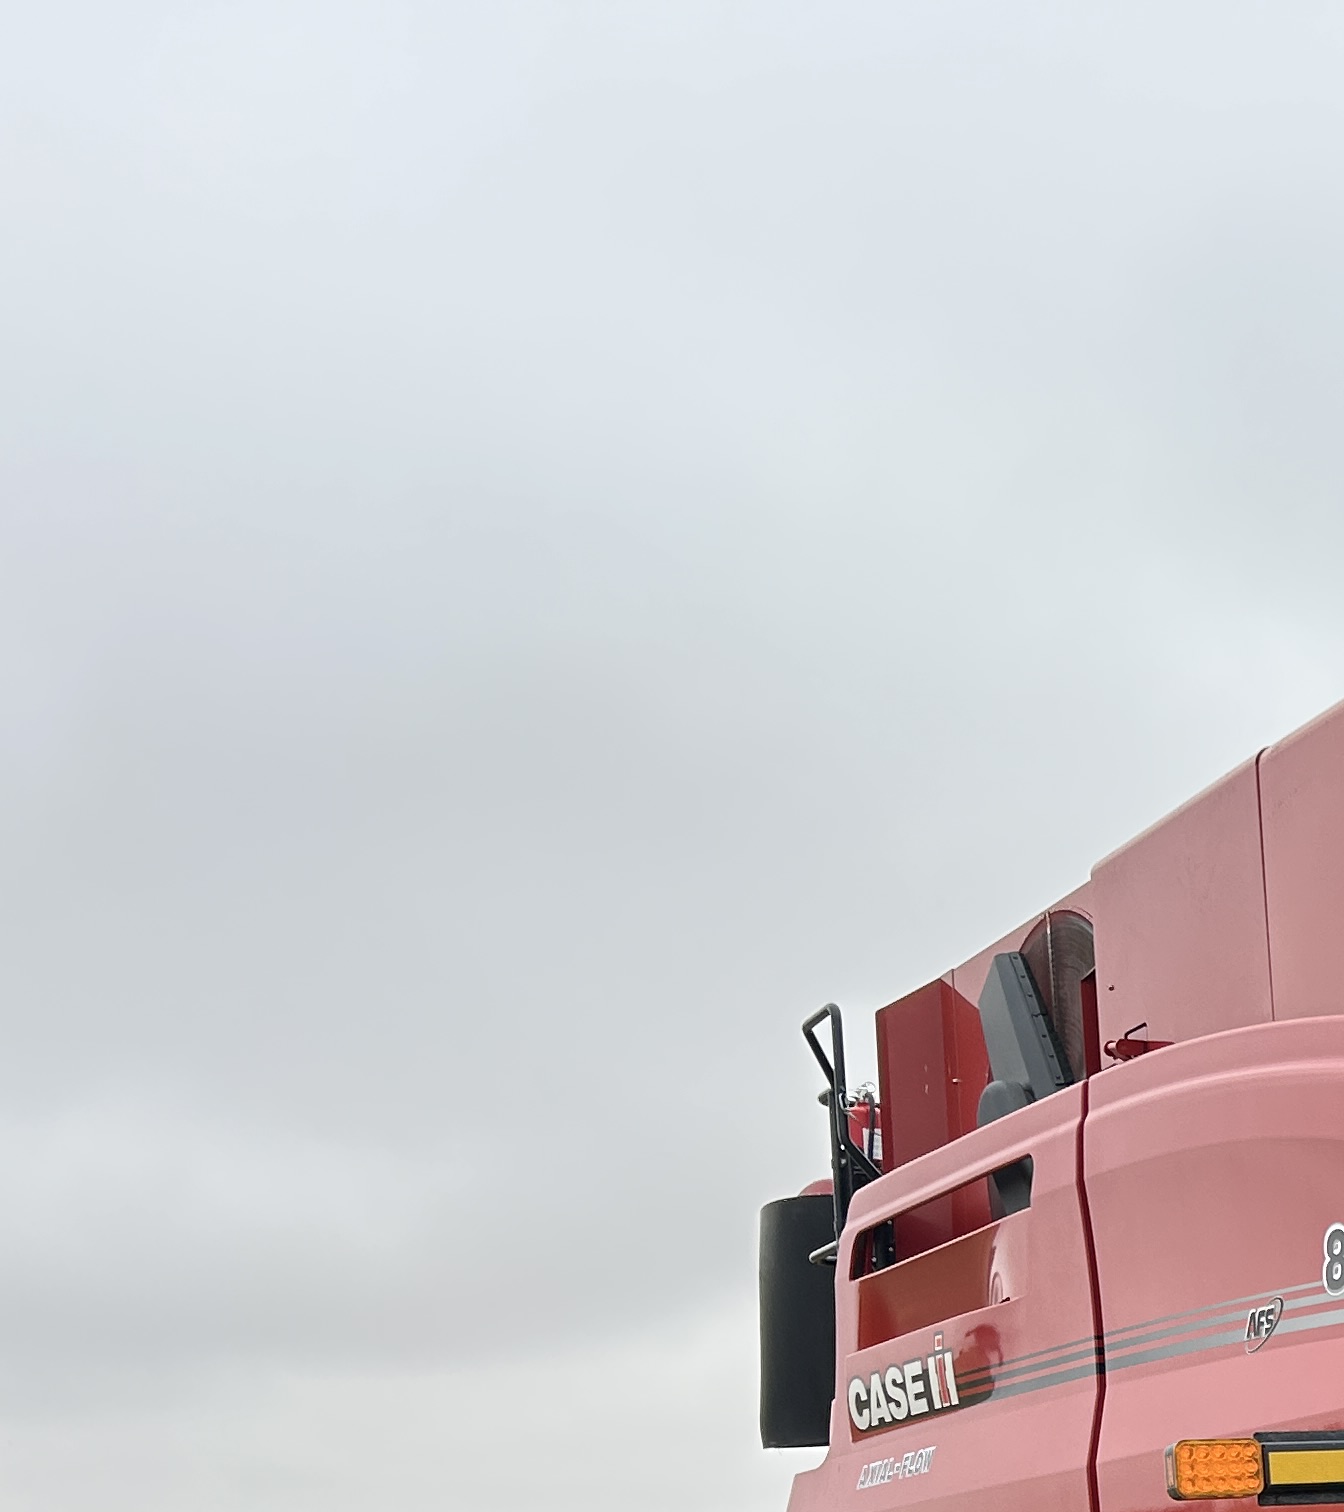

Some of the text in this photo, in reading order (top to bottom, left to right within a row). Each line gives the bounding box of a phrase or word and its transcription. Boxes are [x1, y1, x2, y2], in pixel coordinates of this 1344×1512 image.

[1244, 1304, 1276, 1341] AFS
[848, 1360, 930, 1430] CASE
[856, 1445, 938, 1491] AXIAL-FLOW
